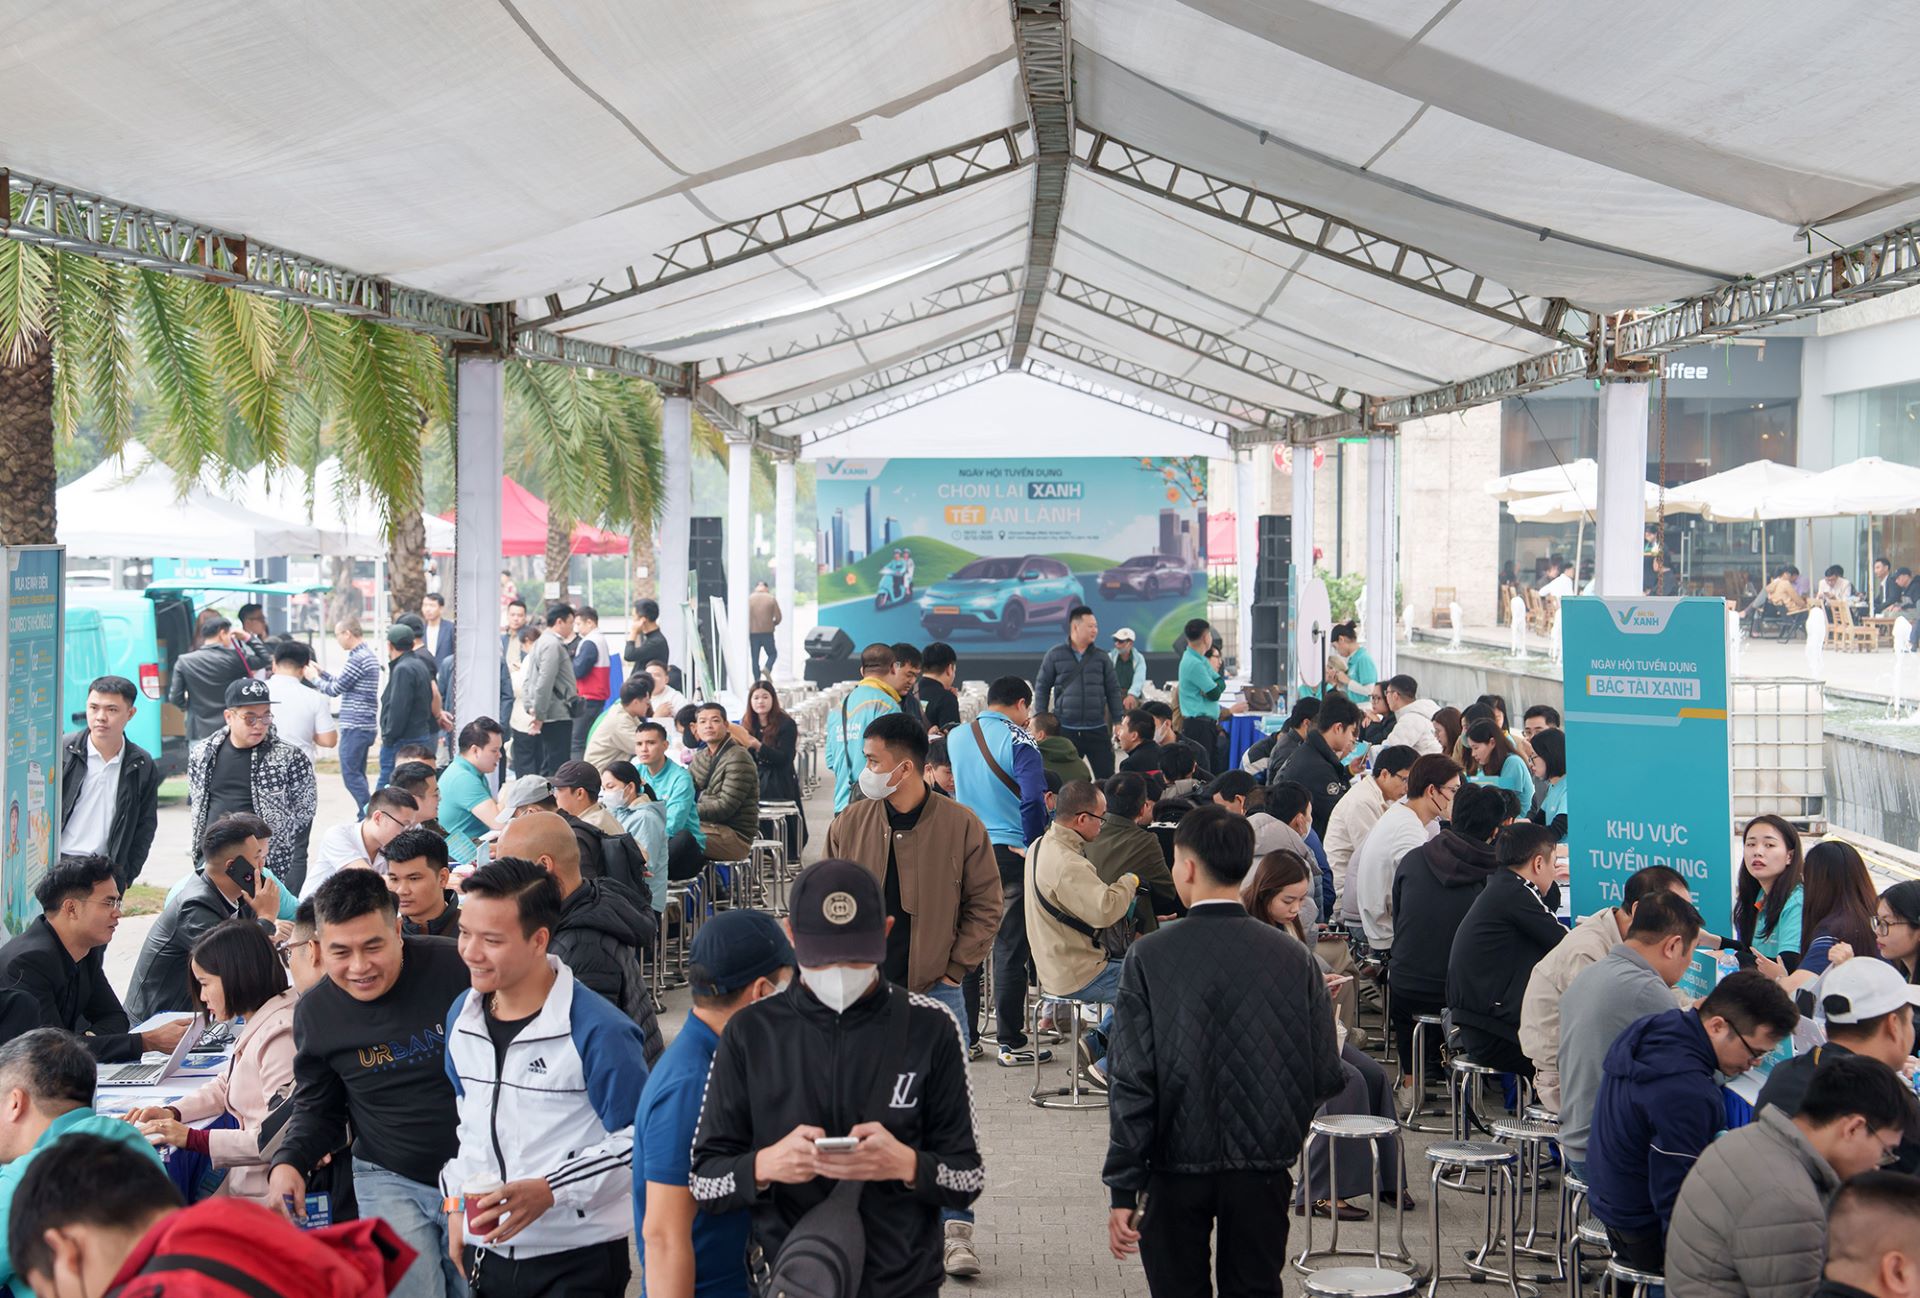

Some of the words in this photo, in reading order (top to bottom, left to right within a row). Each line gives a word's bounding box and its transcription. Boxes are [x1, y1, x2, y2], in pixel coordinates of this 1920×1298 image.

[958, 467, 983, 477] NGÀY
[986, 467, 1000, 478] HỘI
[1036, 468, 1063, 478] DỤNG
[938, 483, 990, 501] CHỌN
[1032, 483, 1081, 498] XANH
[950, 506, 980, 523] TẾT
[989, 507, 1019, 523] AN
[1024, 503, 1081, 523] LÀNH
[1633, 617, 1660, 626] XANH
[1591, 658, 1616, 670] NGÀY
[1618, 658, 1635, 672] HỘI
[1669, 661, 1697, 674] DỤNG
[1596, 676, 1624, 694] BÁC
[1627, 678, 1649, 695] TÀI
[1652, 681, 1693, 697] XANH
[1606, 820, 1644, 841] KHU
[1647, 823, 1689, 847] VỰC
[1588, 847, 1649, 872] TUYỂN
